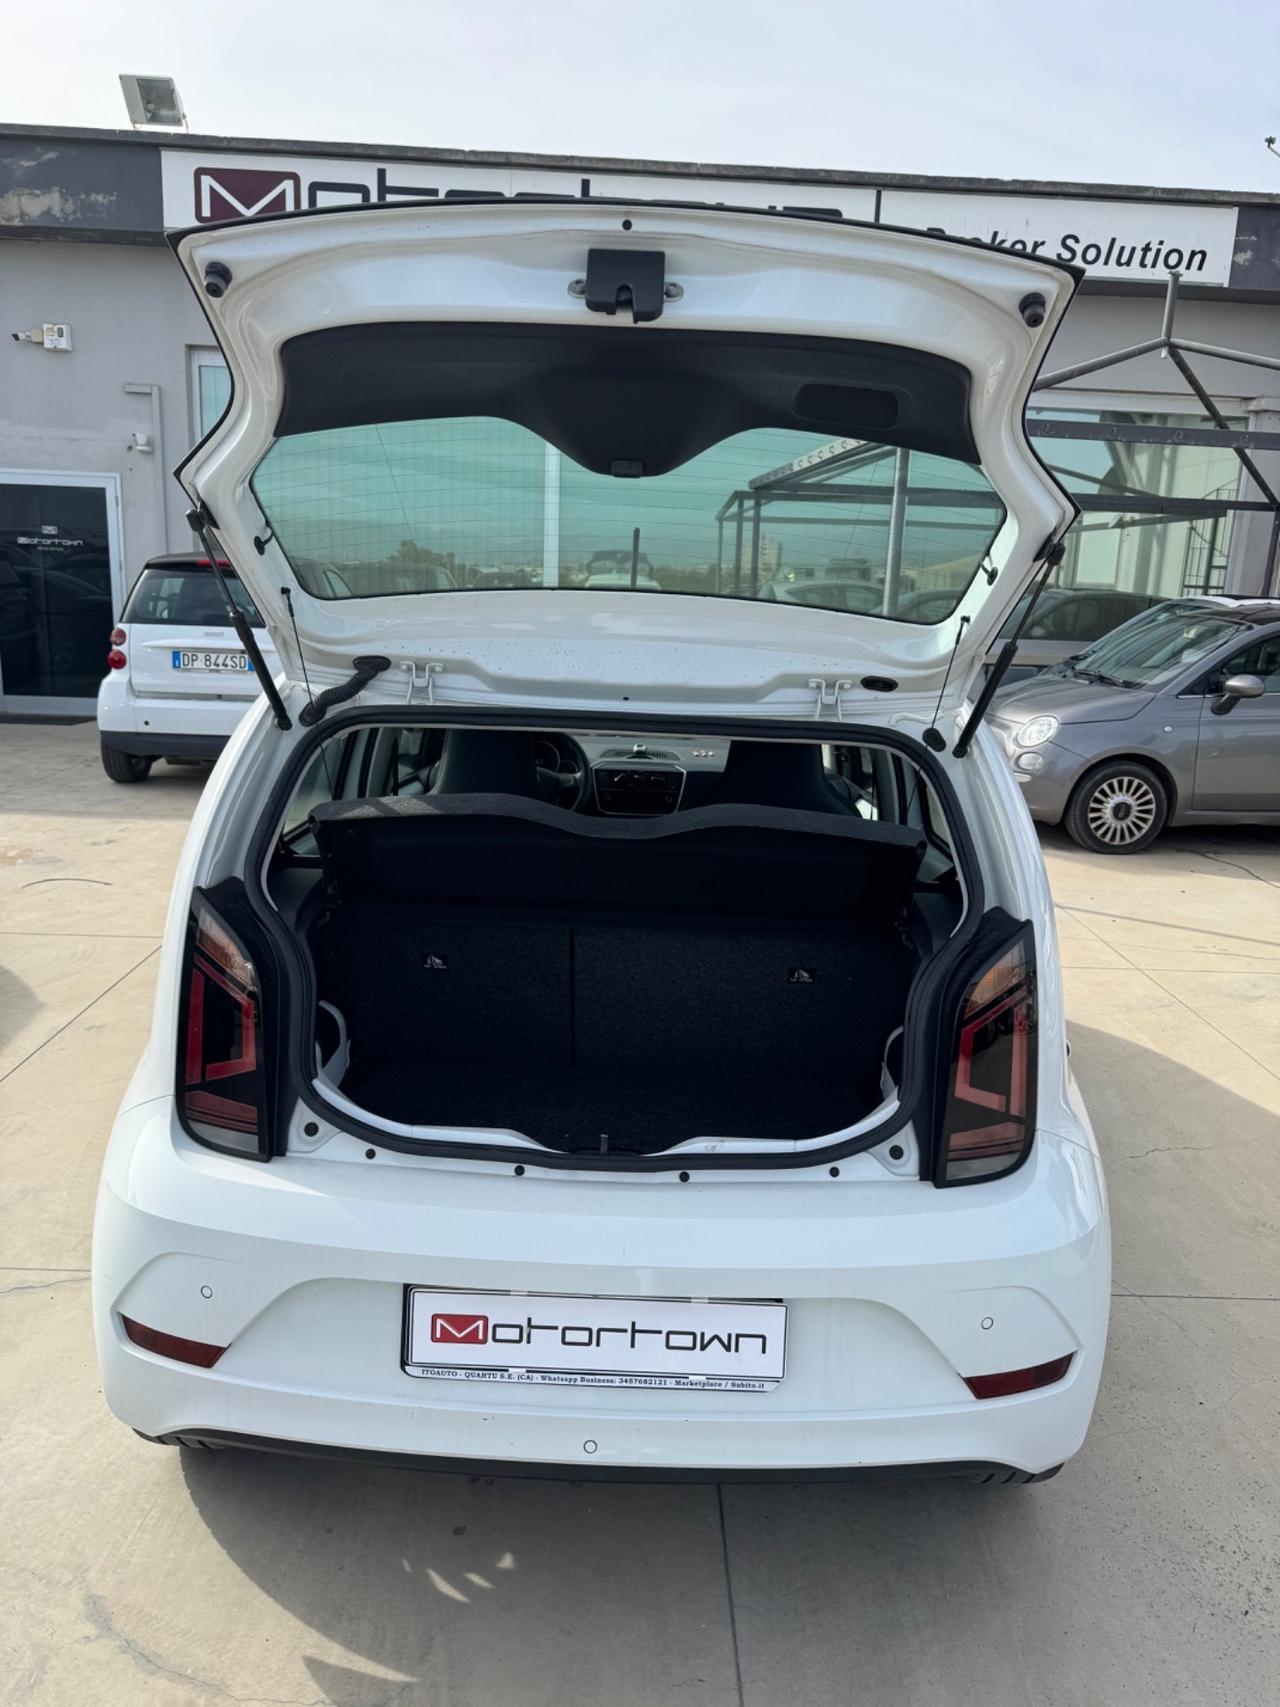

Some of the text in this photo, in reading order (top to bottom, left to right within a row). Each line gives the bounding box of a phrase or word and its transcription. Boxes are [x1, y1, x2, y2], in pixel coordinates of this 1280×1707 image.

[1056, 234, 1207, 271] Solution
[432, 1314, 767, 1354] Motortown
[464, 1371, 498, 1379] QUARTU
[540, 1375, 578, 1383] Whatsapp
[674, 1380, 721, 1389] Marketplace
